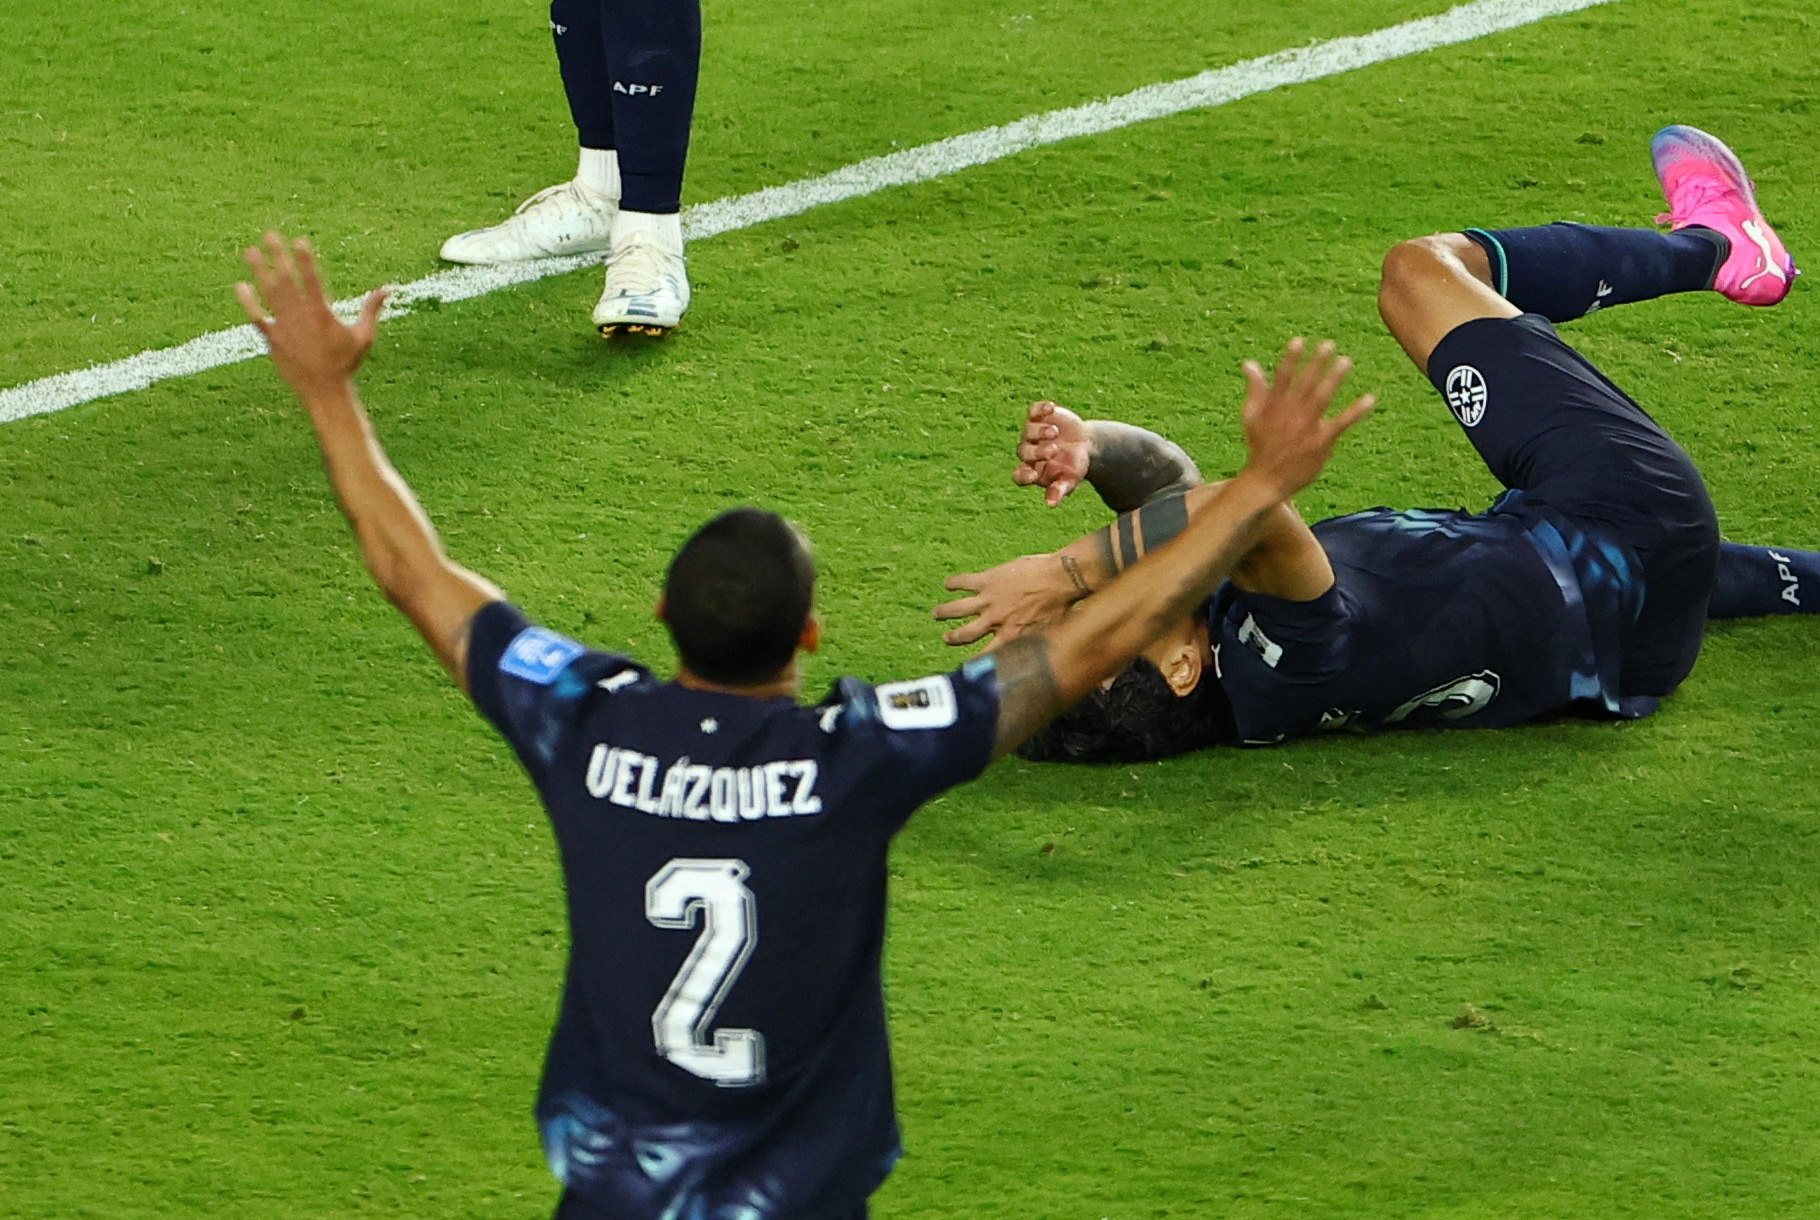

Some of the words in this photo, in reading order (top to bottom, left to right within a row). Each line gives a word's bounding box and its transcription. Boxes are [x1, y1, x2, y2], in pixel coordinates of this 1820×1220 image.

[613, 81, 664, 97] APF
[1768, 549, 1801, 607] APF
[645, 857, 766, 1088] 2
